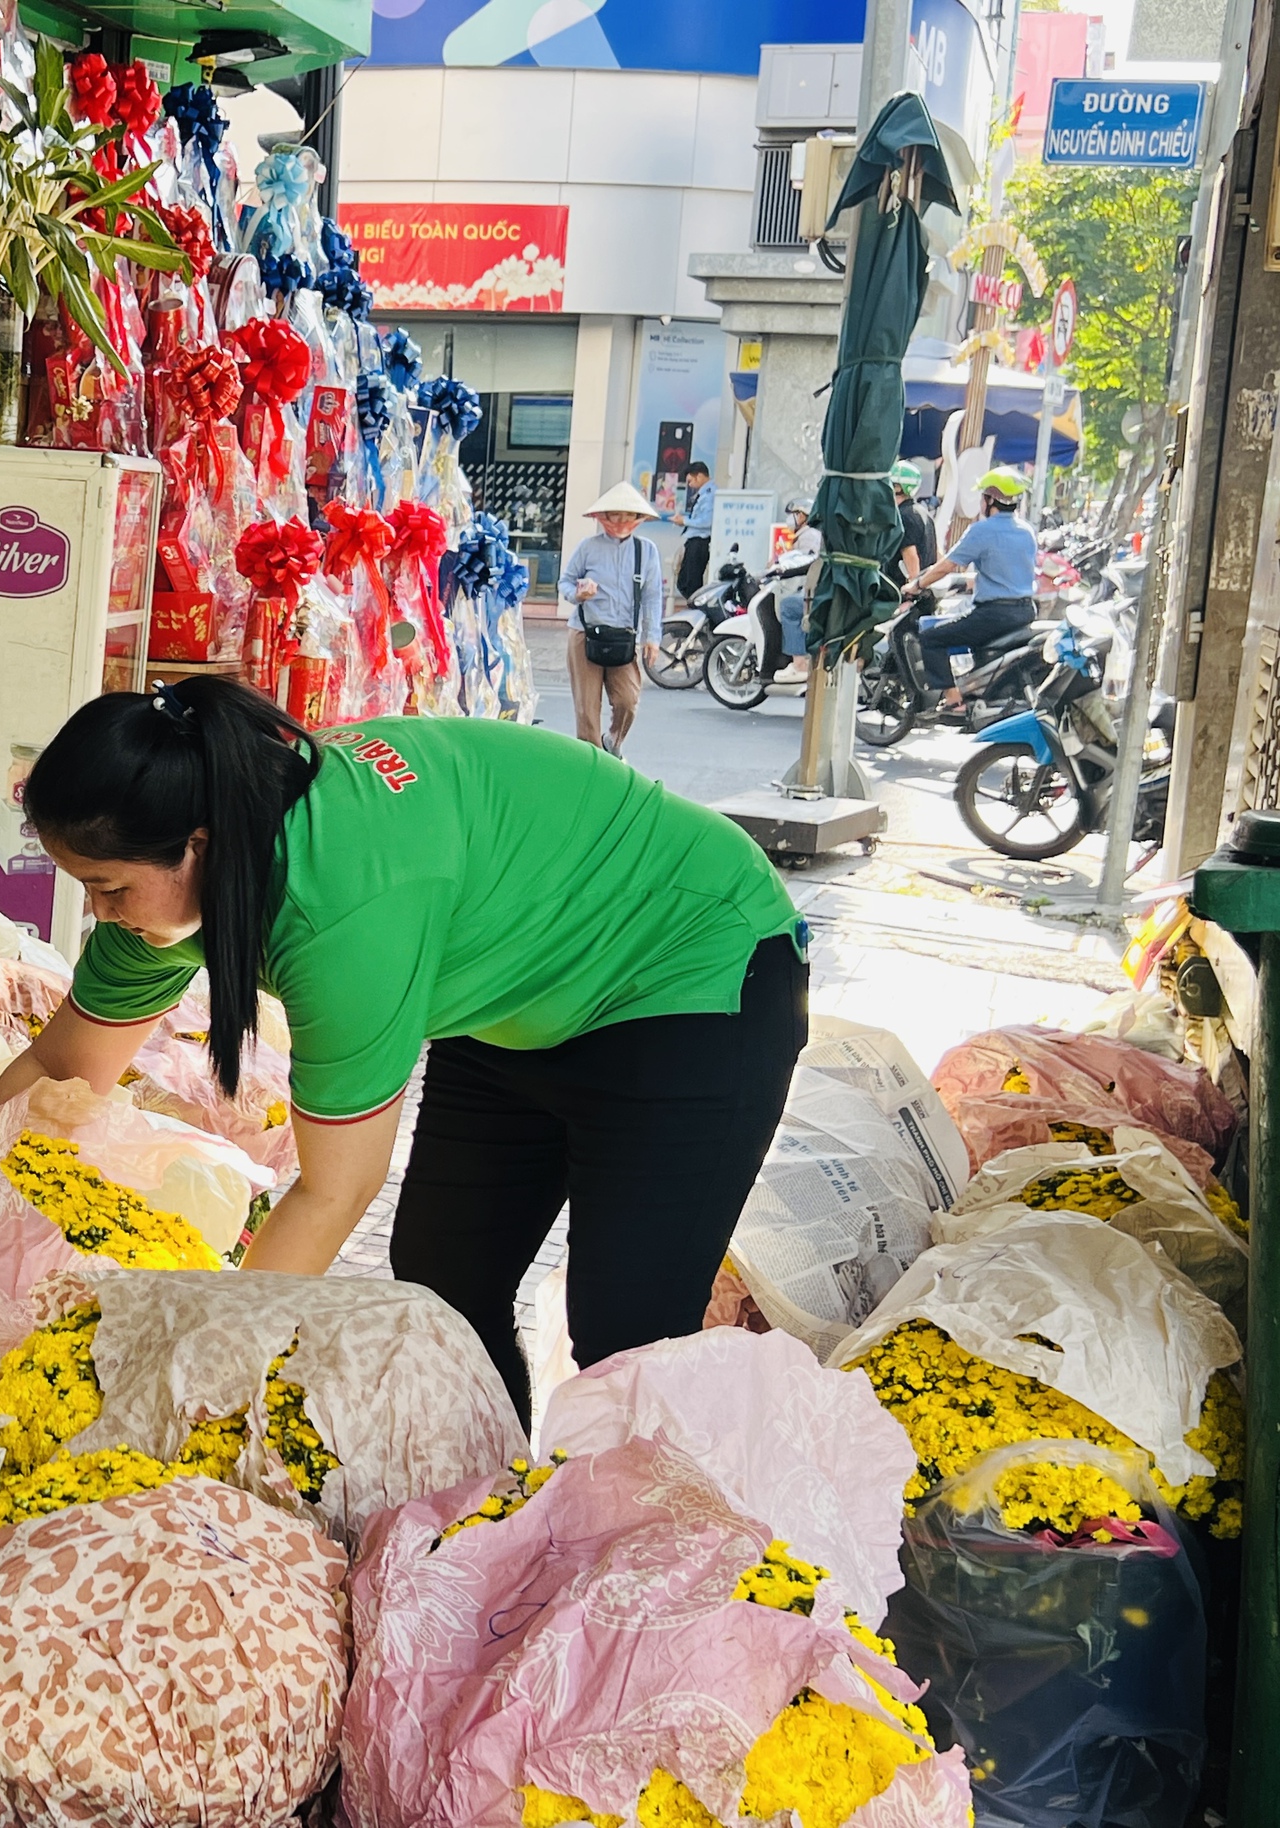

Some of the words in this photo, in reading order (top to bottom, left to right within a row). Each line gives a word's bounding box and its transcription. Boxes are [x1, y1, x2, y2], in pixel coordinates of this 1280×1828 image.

[918, 20, 947, 87] MB
[1082, 89, 1170, 114] ĐƯỜNG
[1048, 121, 1107, 156] NGUYỄN
[1109, 122, 1146, 157] ĐÌNH
[1148, 118, 1193, 158] CHIỂU
[363, 218, 405, 240] BIỂU
[409, 219, 459, 240] TOÀN
[462, 219, 522, 242] QUỐC
[352, 738, 418, 794] TRÁI
